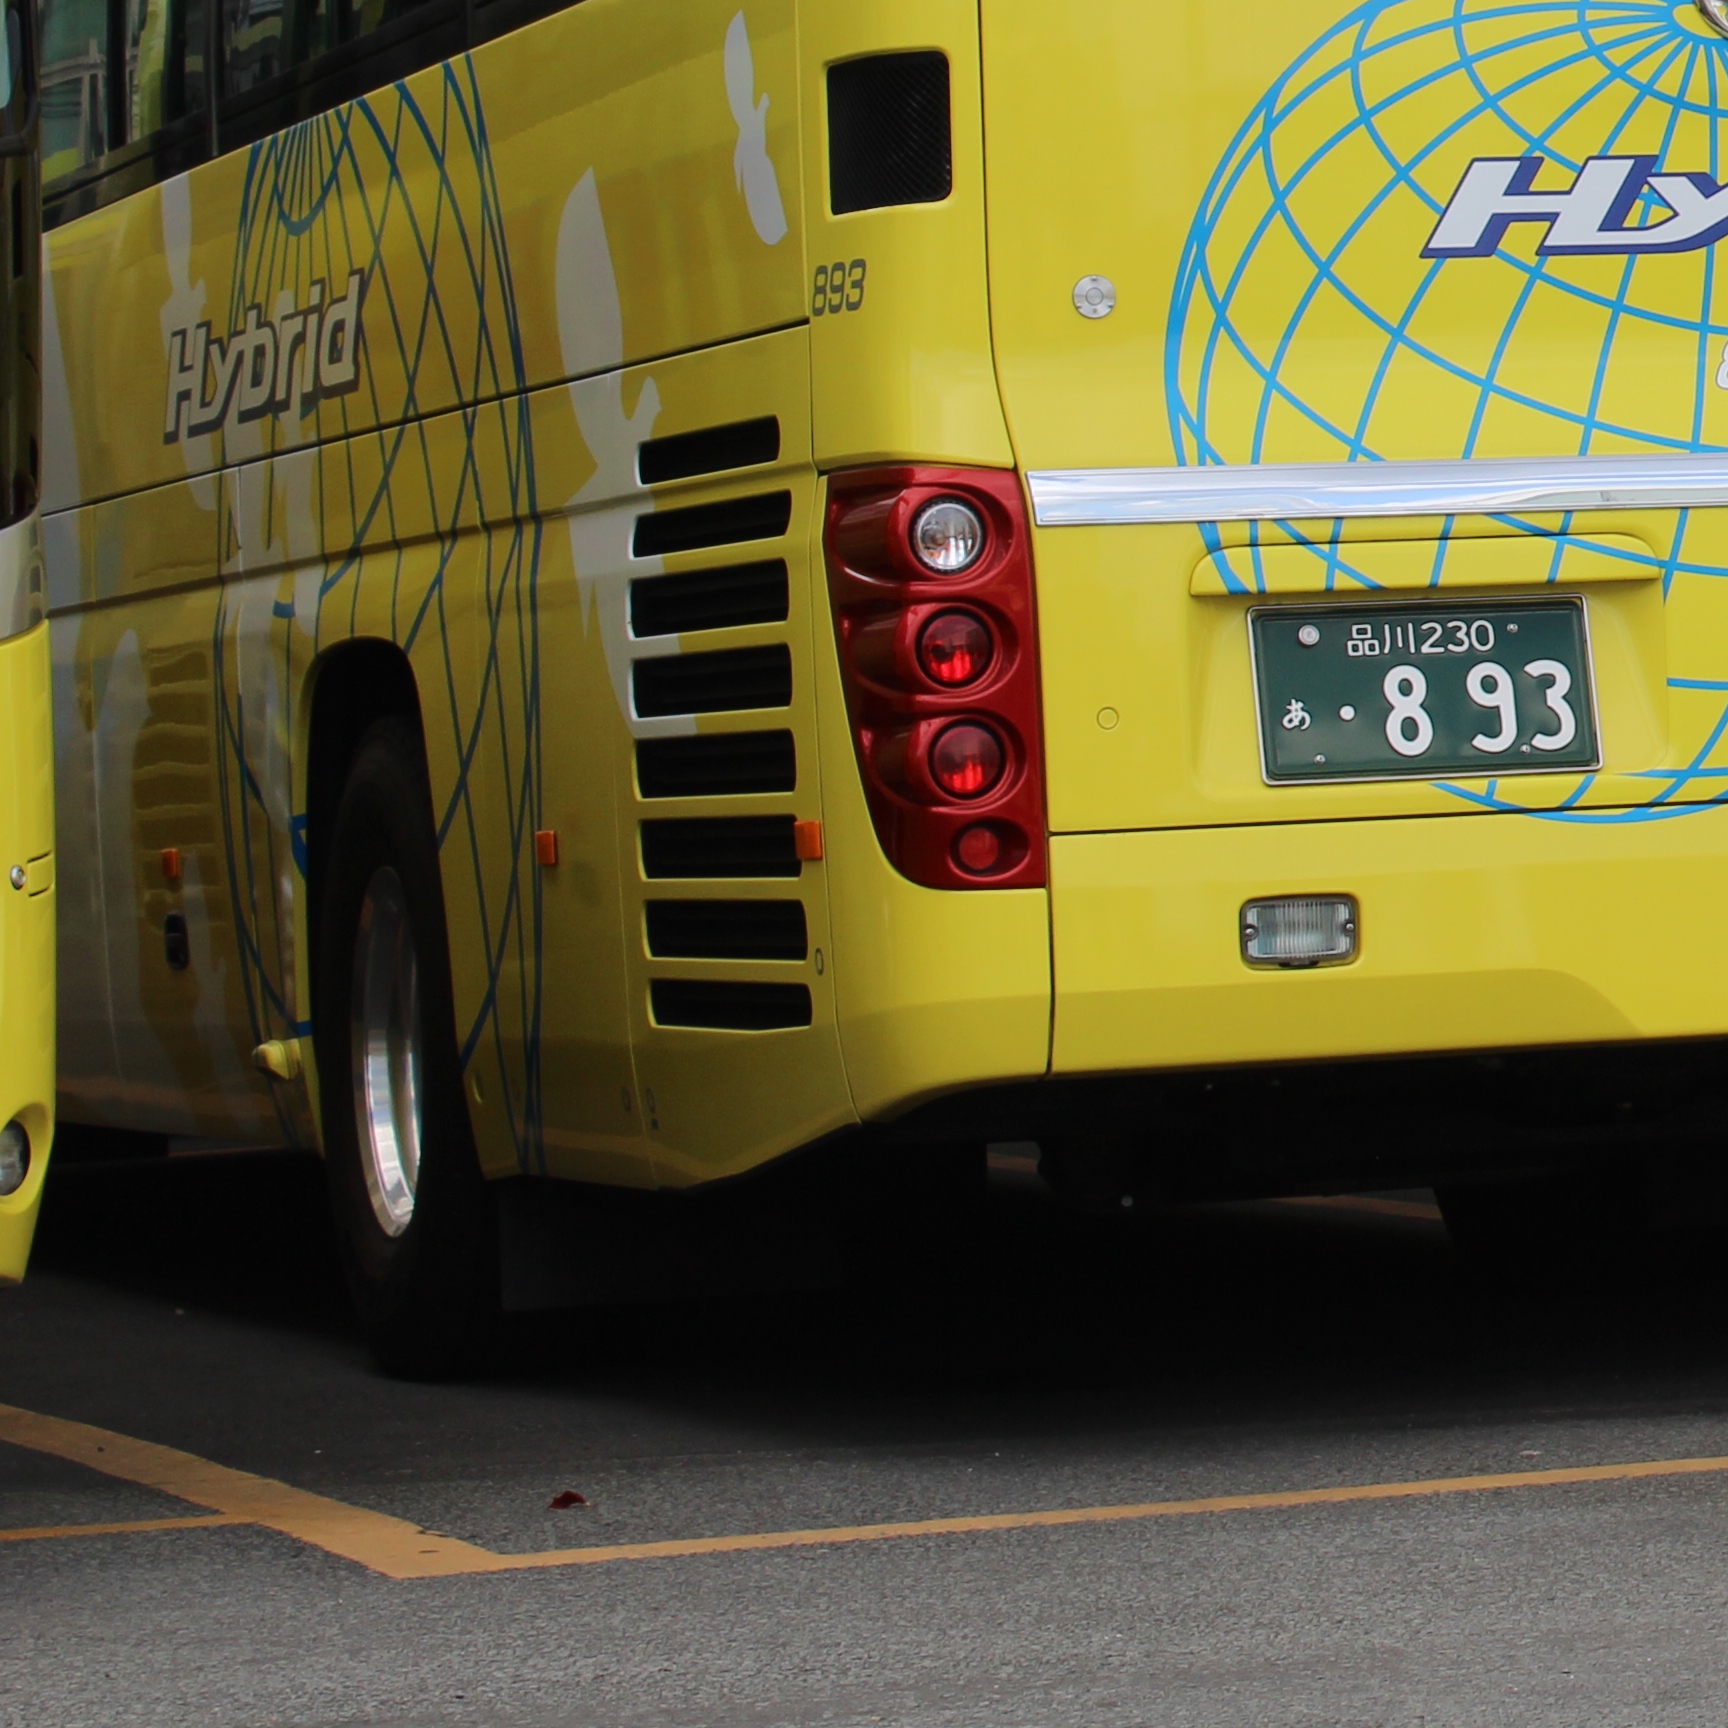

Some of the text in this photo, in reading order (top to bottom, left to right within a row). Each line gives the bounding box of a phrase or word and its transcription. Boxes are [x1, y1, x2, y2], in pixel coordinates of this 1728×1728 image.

[812, 258, 867, 317] 893
[163, 267, 367, 445] Hybrid
[1281, 698, 1312, 731] あ
